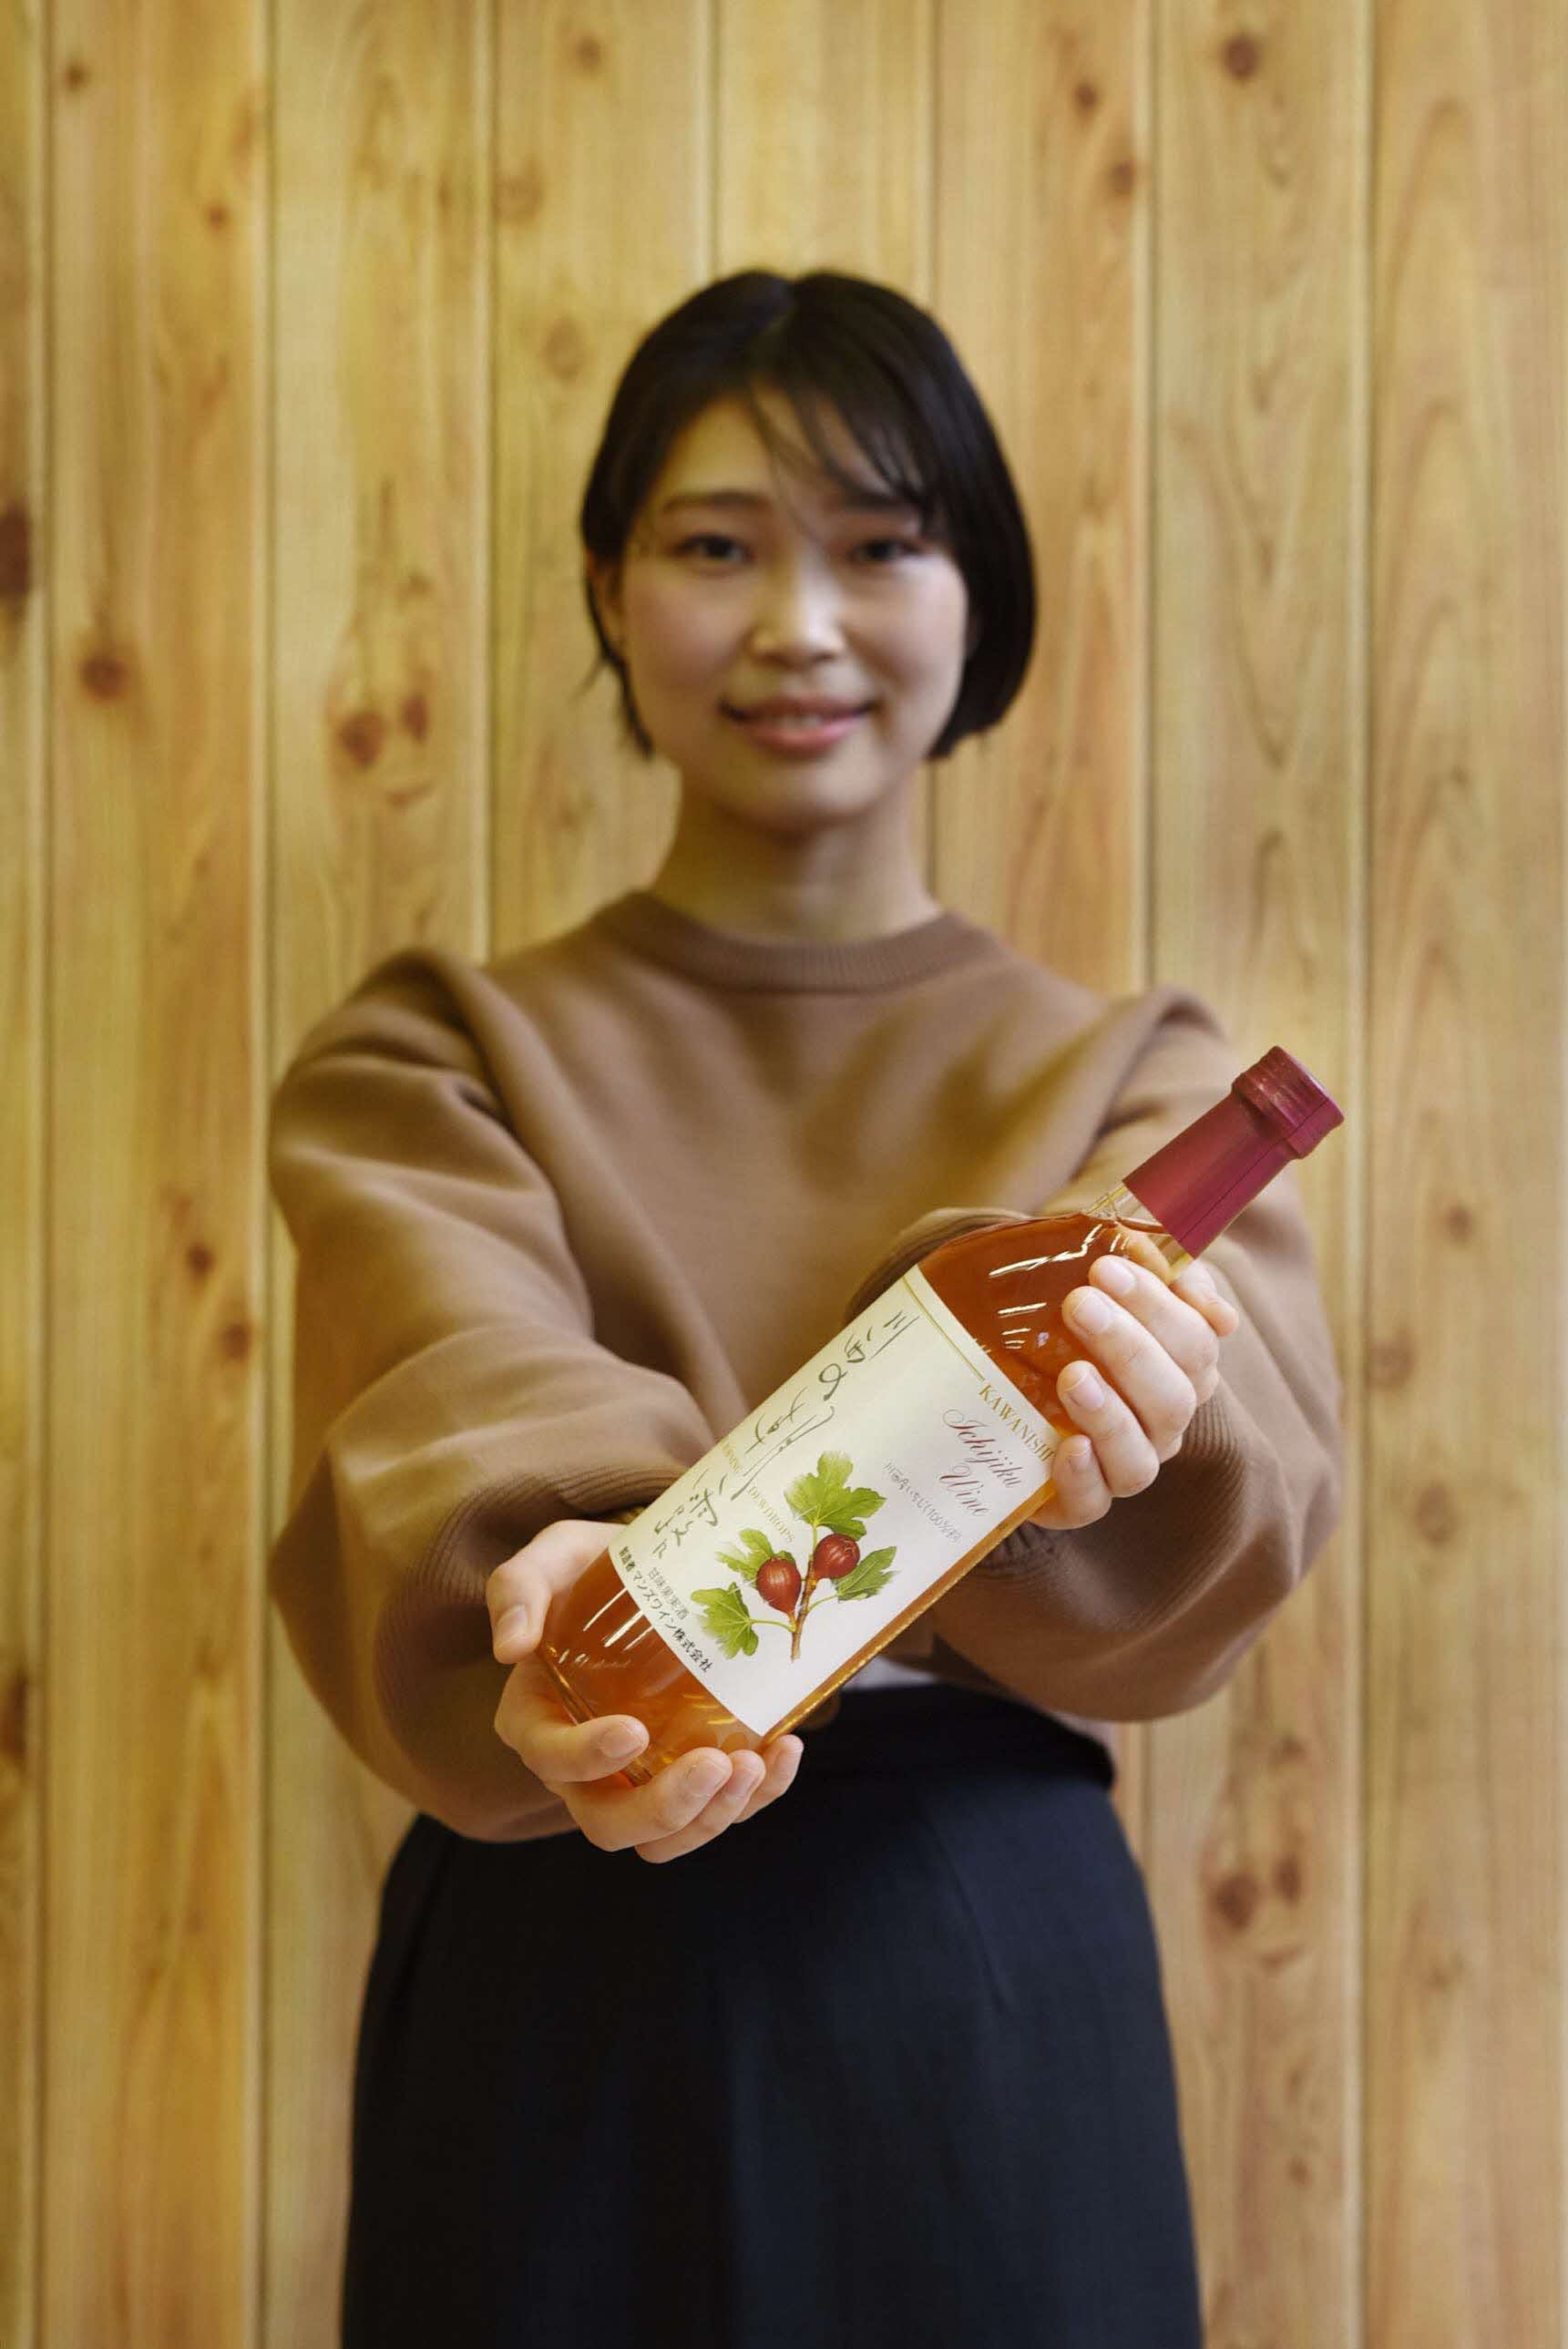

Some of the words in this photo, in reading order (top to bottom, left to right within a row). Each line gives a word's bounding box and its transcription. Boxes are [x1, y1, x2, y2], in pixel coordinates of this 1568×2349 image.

[942, 1409, 1023, 1488] Ichijiku
[978, 1384, 1056, 1462] KAWANISHI
[938, 1463, 989, 1516] Wine
[648, 1566, 690, 1620] 甘味果実酒
